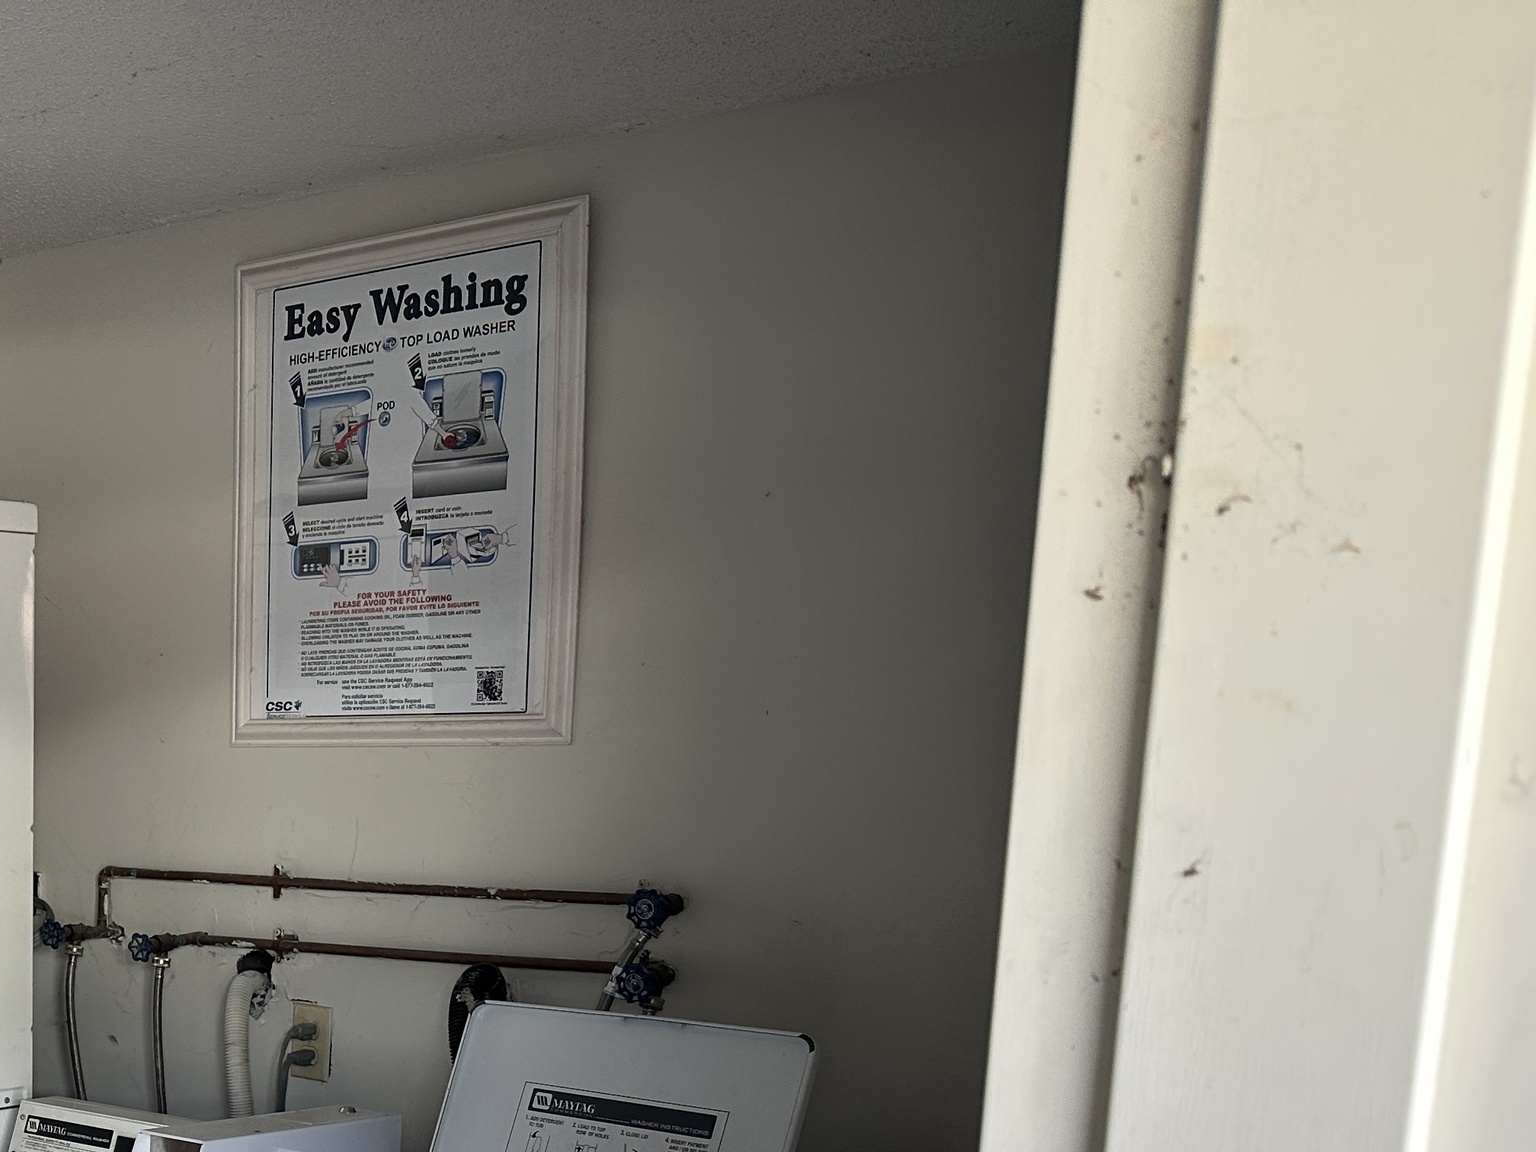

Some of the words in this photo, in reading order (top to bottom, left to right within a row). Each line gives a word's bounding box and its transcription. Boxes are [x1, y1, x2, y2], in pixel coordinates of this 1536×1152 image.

[283, 303, 362, 343] Easy
[368, 272, 528, 327] Washing
[289, 340, 382, 366] HIGH-EFFICIENCY
[400, 334, 424, 348] TOP
[426, 328, 460, 344] LOAD
[462, 320, 516, 339] WASHER
[414, 368, 422, 380] 2
[294, 385, 301, 397] 1
[377, 400, 395, 411] POD
[400, 511, 408, 523] 4
[288, 524, 295, 536] 3
[397, 588, 427, 597] SAFETY
[333, 600, 361, 608] PLEASE
[363, 598, 386, 607] AVOID
[389, 598, 404, 606] THE
[406, 594, 452, 604] FOLLOWING
[266, 701, 292, 712] CSC
[552, 1098, 596, 1114] MAYTAG
[540, 1116, 565, 1125] DETERGENT
[39, 1123, 67, 1136] MAYTAG
[631, 1120, 659, 1128] WASHER
[660, 1123, 709, 1136] INSTRUCTIONS
